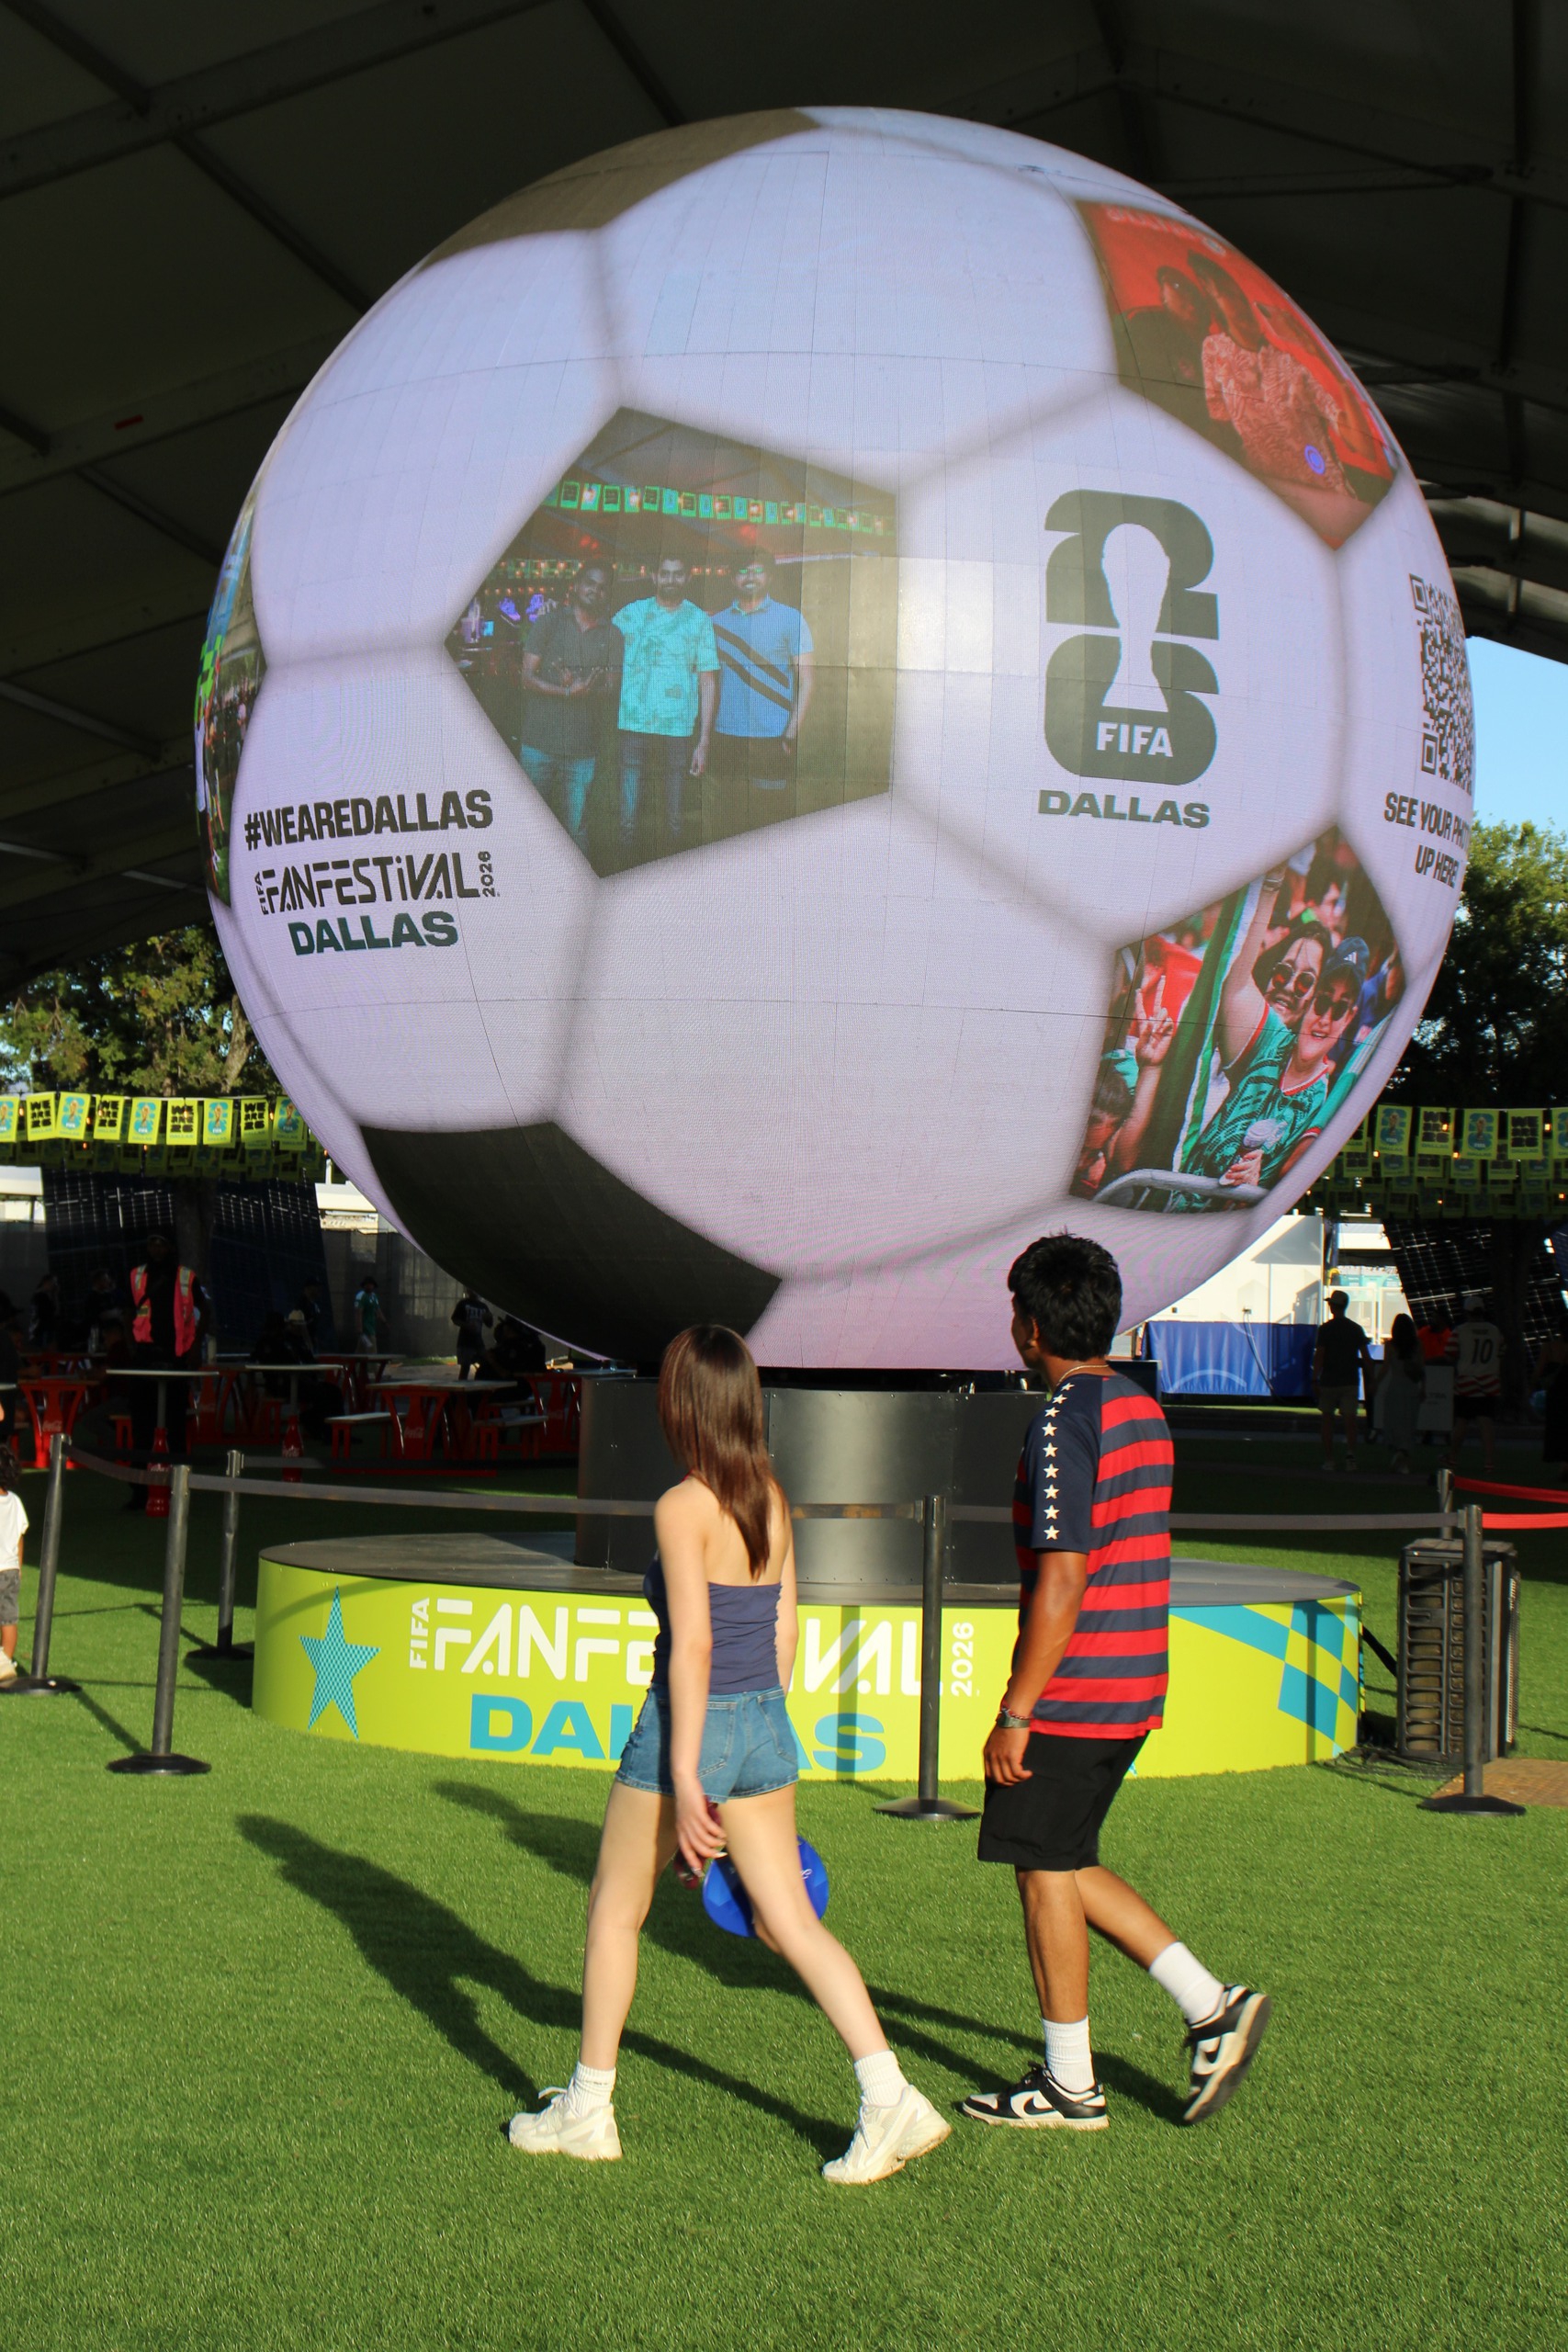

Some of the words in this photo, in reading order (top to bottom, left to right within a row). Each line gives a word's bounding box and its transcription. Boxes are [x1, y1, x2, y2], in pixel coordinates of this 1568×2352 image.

[1096, 721, 1173, 758] FIFA
[244, 789, 494, 851] #WEAREDALLAS
[1038, 788, 1210, 829] DALLAS
[1383, 791, 1418, 828] SEE
[1420, 800, 1452, 841] YOUR
[477, 850, 496, 898] 2026
[1415, 844, 1436, 876] UP
[1433, 851, 1460, 888] HERE
[254, 872, 270, 915] FIFA
[288, 910, 459, 956] DALLAS
[1472, 1339, 1494, 1364] 10
[410, 1597, 430, 1669] FIFA
[434, 1598, 942, 1696] FANFEVAL
[950, 1621, 975, 1697] 2026
